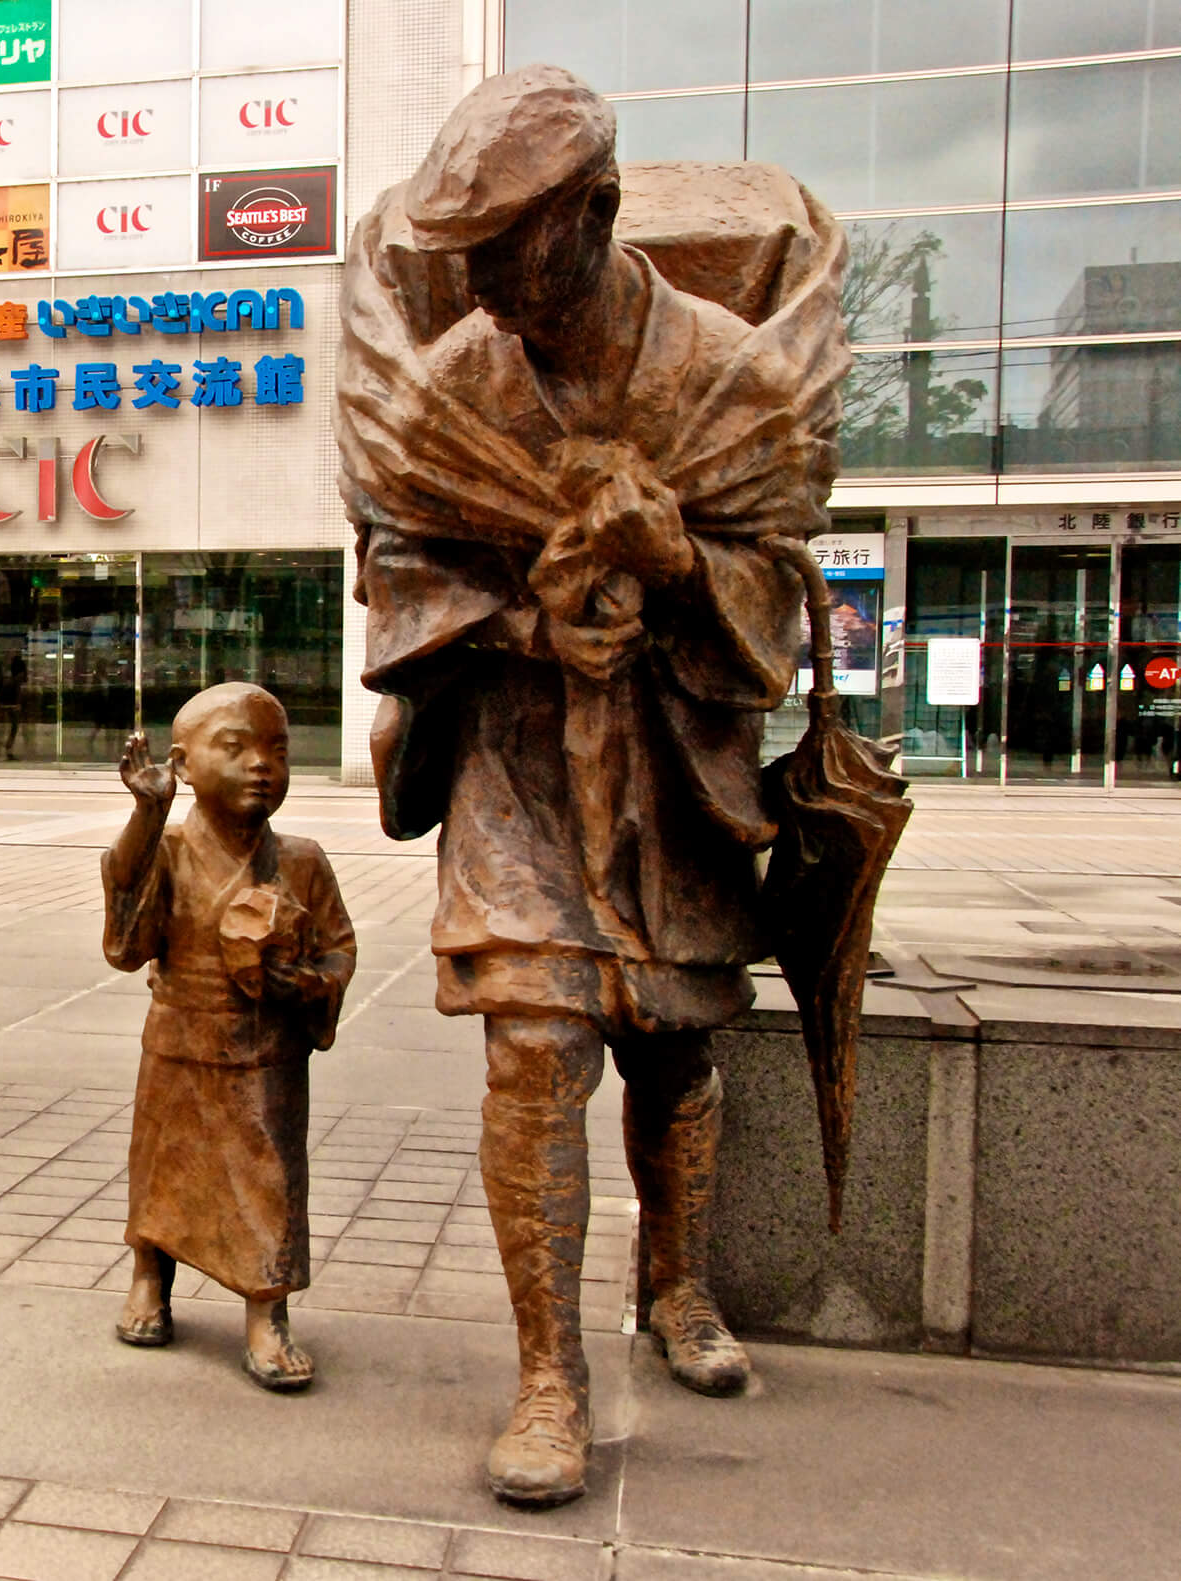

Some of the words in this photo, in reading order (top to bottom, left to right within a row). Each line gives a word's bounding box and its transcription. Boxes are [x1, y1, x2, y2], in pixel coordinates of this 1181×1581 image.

[240, 98, 298, 128] CIC
[97, 109, 153, 138] CIC
[204, 178, 222, 192] 1F
[97, 204, 153, 233] CIC
[226, 208, 278, 227] SEATTLE'S
[279, 207, 308, 223] BEST
[241, 228, 293, 244] COFFEE
[1058, 512, 1181, 530] 北陸銀行
